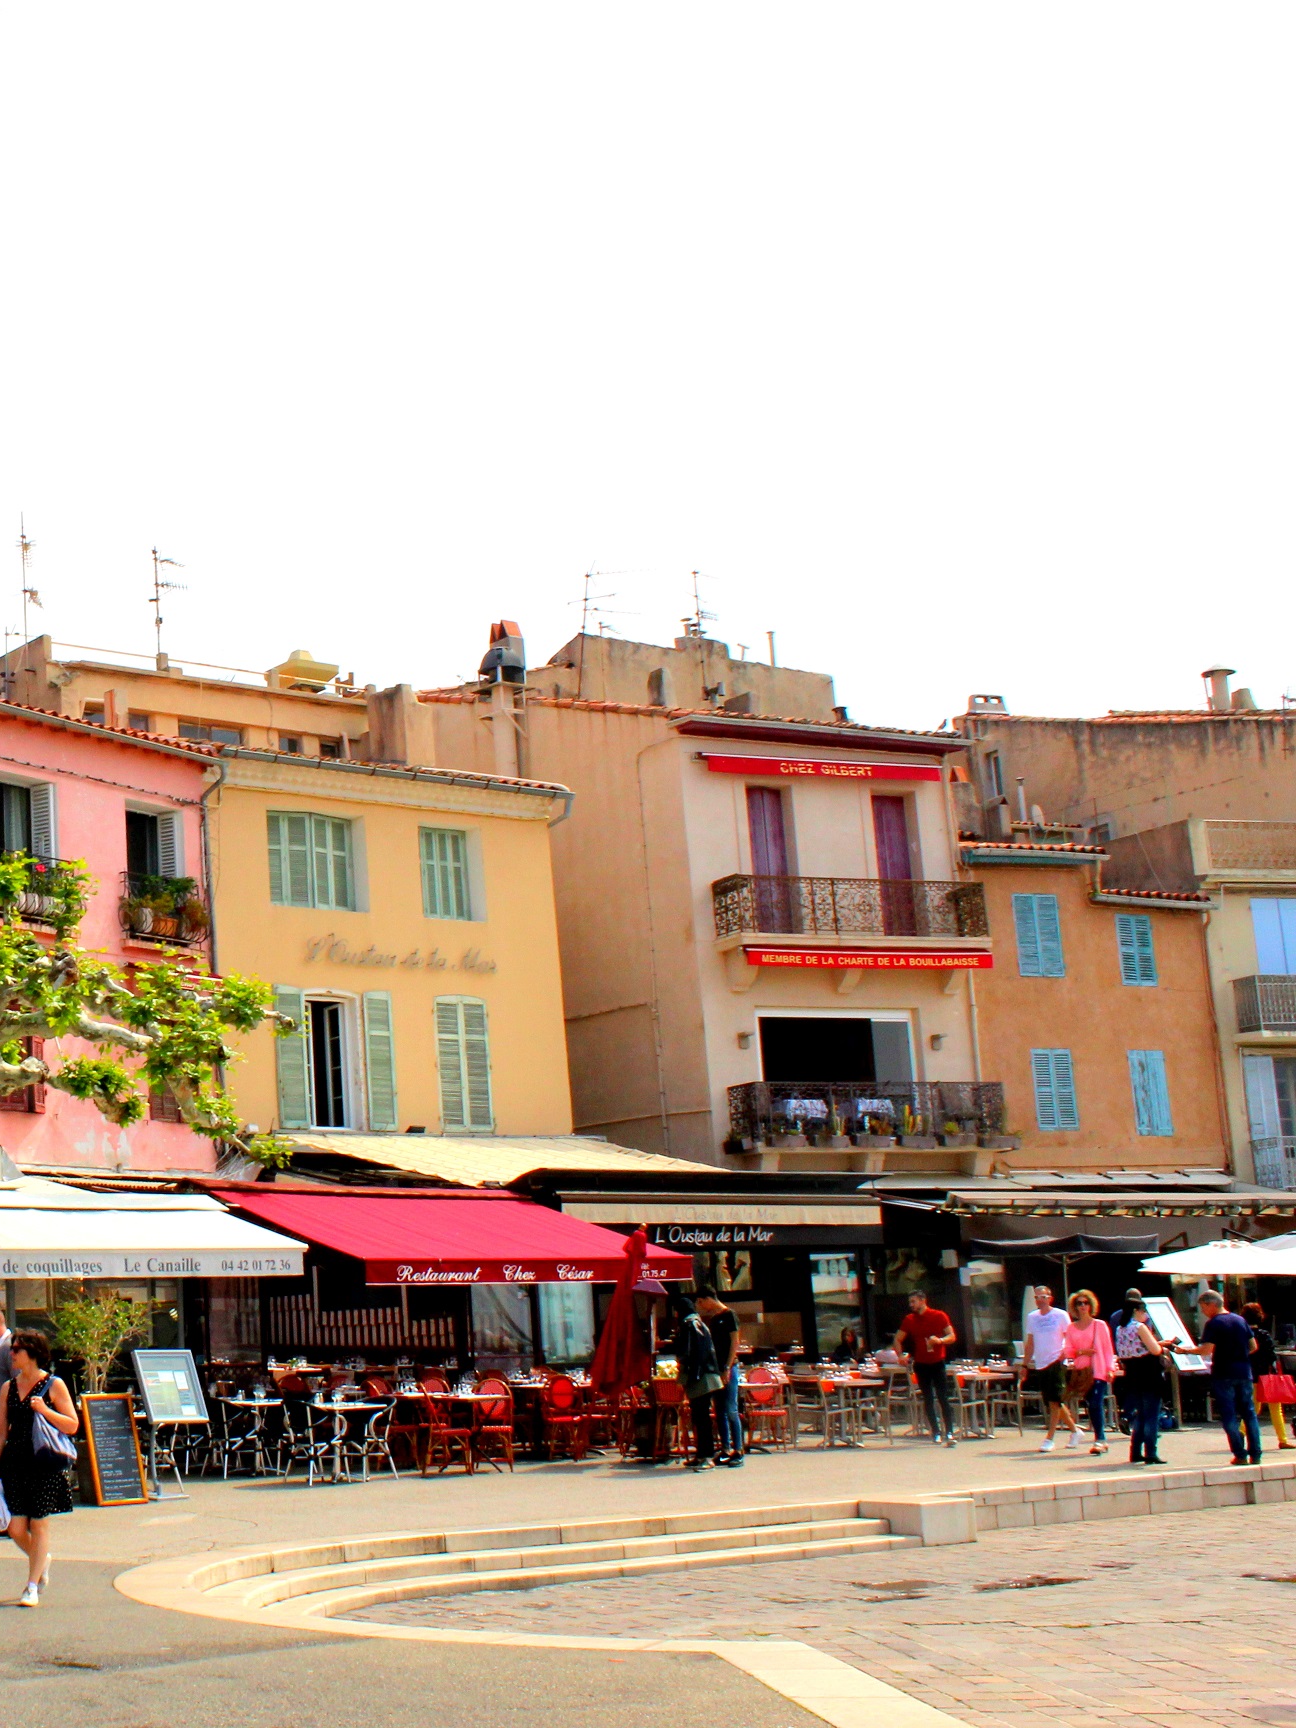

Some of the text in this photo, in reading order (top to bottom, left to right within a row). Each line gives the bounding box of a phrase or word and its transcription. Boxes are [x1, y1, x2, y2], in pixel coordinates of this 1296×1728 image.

[780, 762, 872, 776] CHEZ GILBERT
[761, 954, 979, 967] MEMBRE DE LA CHARTE DE LA BOUILLABAISSE
[716, 1226, 731, 1242] de
[734, 1226, 745, 1242] la
[748, 1226, 774, 1242] Mar
[3, 1258, 19, 1274] de
[26, 1258, 103, 1277] coquillages
[124, 1258, 141, 1273] Le
[147, 1257, 201, 1273] Canaille
[221, 1260, 234, 1271] 04
[237, 1260, 249, 1271] 42
[252, 1260, 262, 1271] 01
[265, 1260, 277, 1271] 72
[279, 1260, 291, 1271] 36
[396, 1263, 594, 1282] Restaurant Chez César
